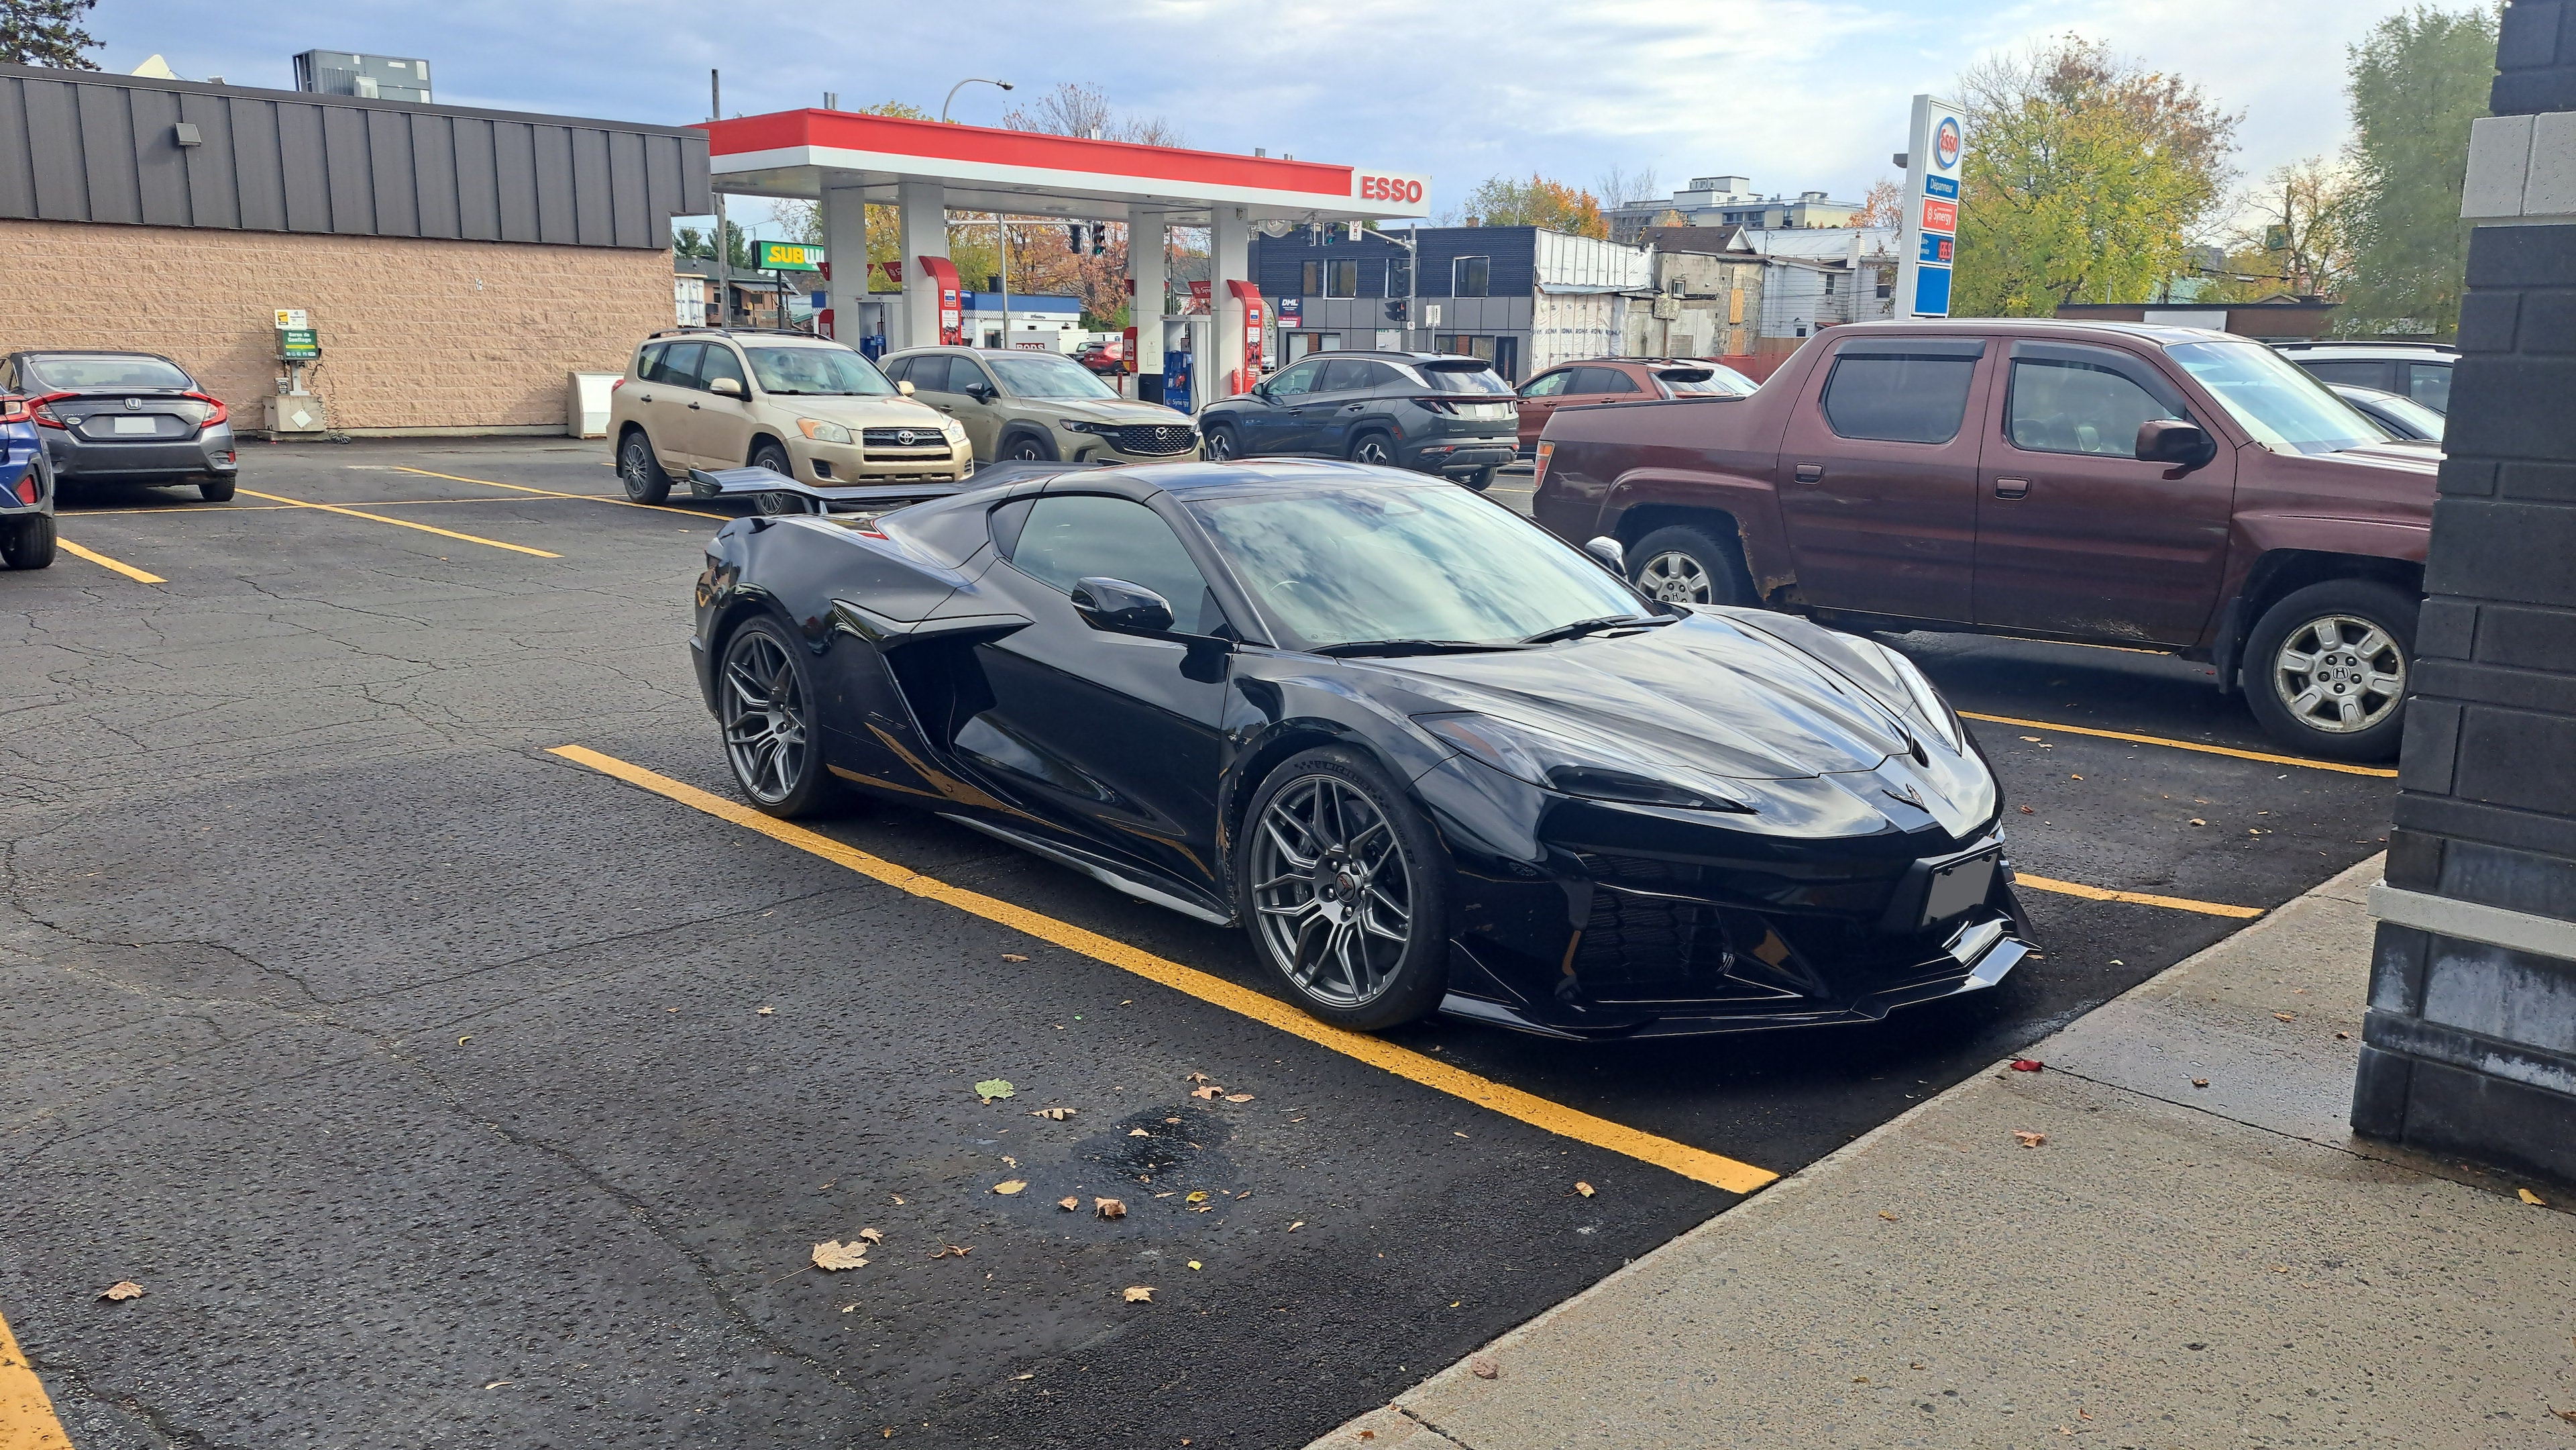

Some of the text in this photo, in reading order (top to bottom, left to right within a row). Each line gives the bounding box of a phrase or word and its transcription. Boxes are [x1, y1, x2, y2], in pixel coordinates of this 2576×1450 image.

[1360, 175, 1423, 203] ESSO
[1930, 178, 1953, 193] Dépanneur
[1933, 208, 1952, 225] Synergy
[1172, 399, 1189, 407] Synergy
[1324, 762, 1372, 792] MICHELIN
